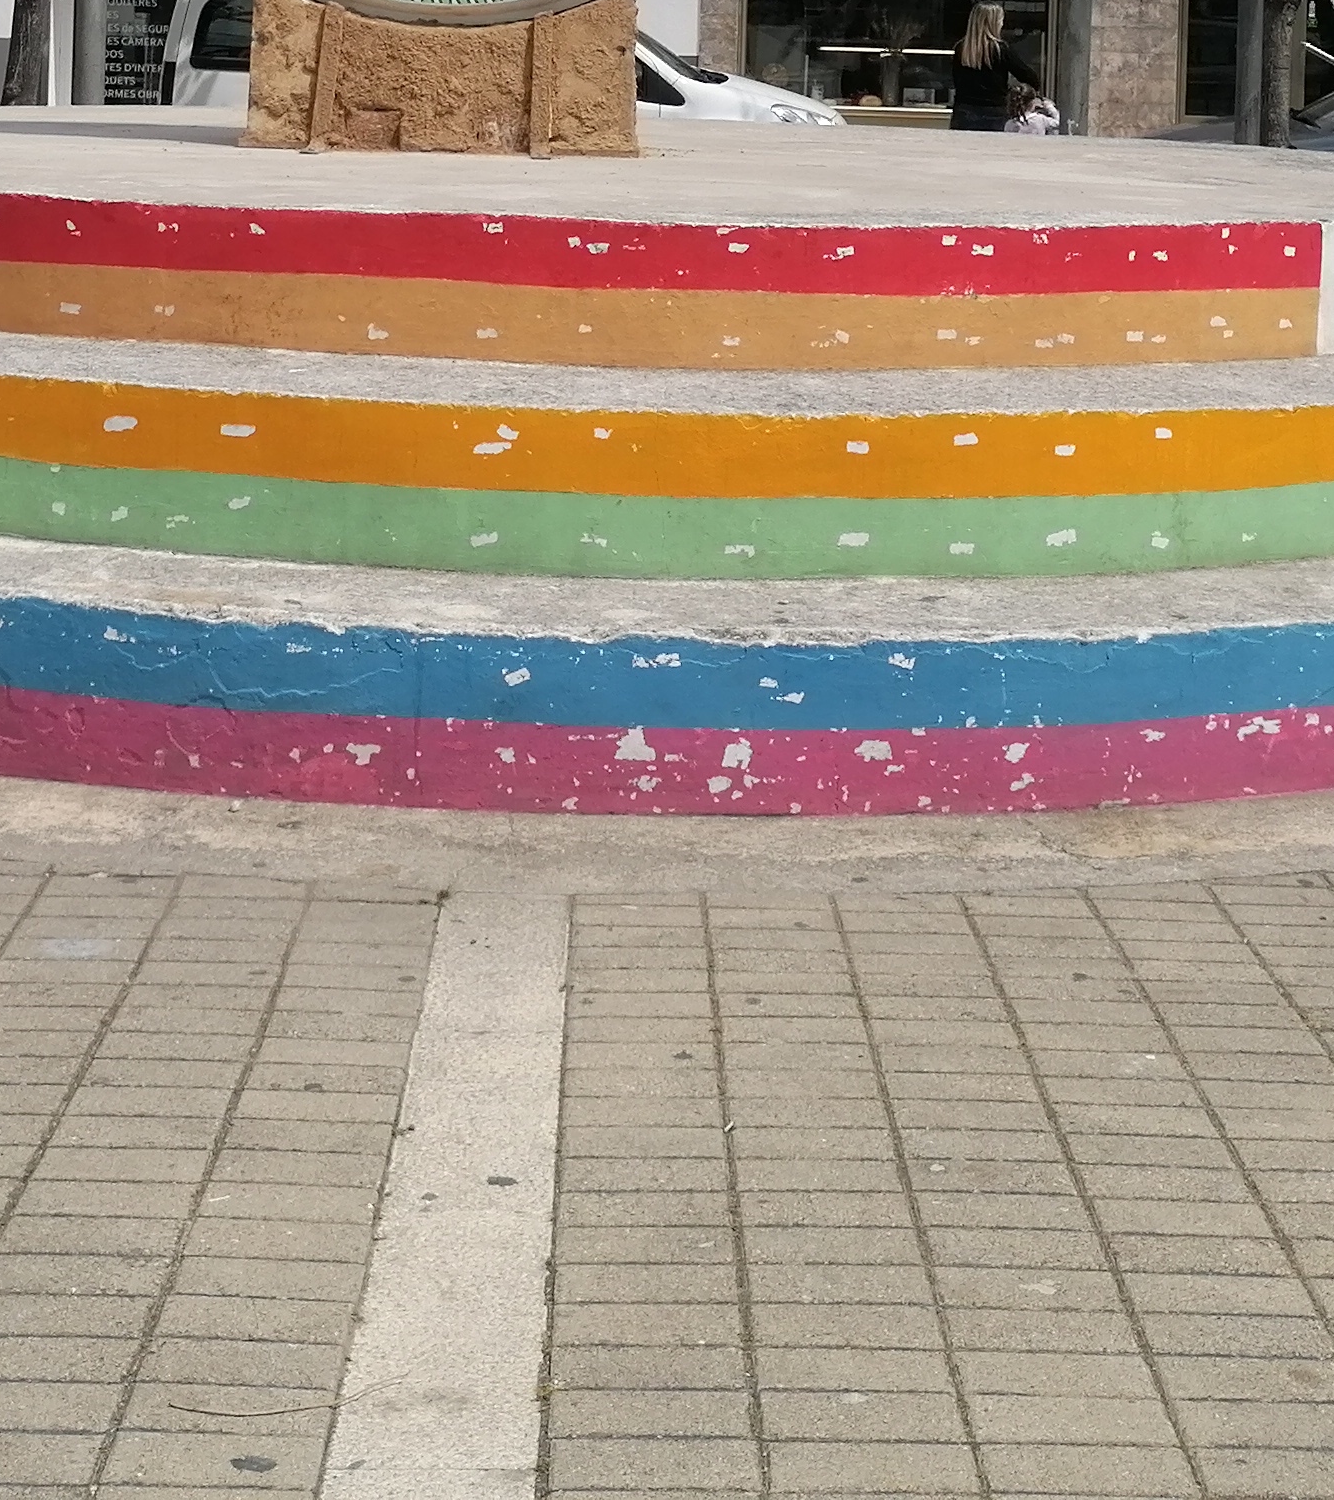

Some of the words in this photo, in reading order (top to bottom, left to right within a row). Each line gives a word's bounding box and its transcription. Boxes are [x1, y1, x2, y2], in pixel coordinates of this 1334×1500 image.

[107, 23, 120, 33] ES
[135, 24, 170, 34] SEGUR
[107, 36, 120, 46] ES
[105, 50, 124, 59] DOS
[105, 63, 122, 72] TES
[124, 63, 163, 73] D'INTER
[105, 76, 136, 86] QUETS
[104, 89, 136, 99] ORMES
[137, 89, 160, 99] OBR
